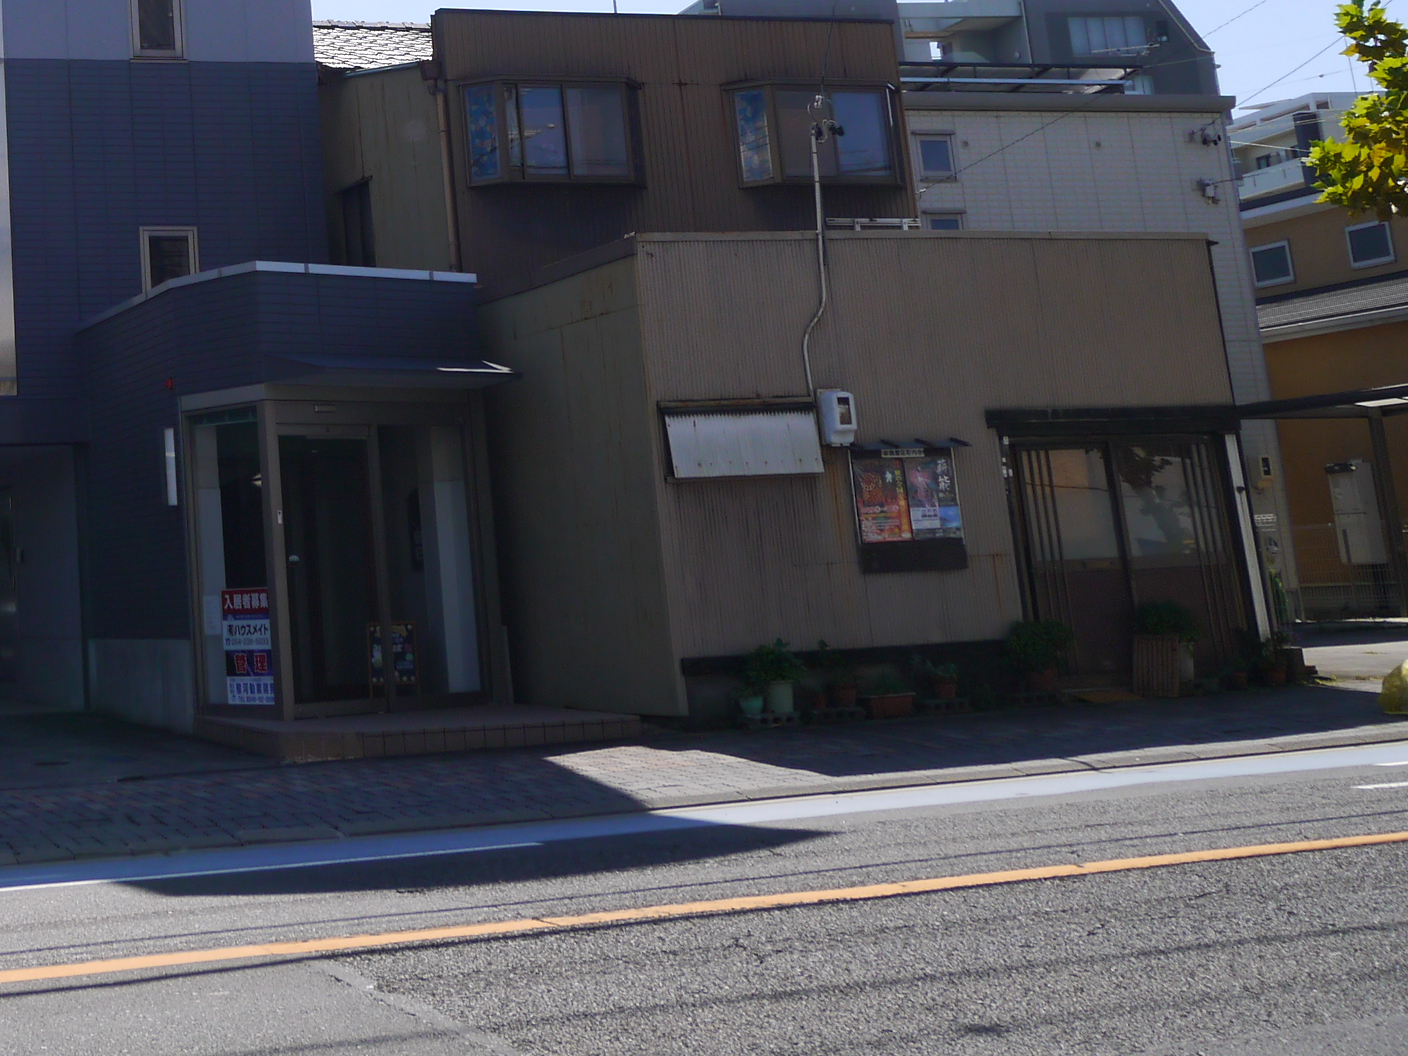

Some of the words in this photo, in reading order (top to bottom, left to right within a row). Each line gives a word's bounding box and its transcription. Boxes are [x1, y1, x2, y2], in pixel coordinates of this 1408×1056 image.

[223, 593, 269, 610] 入居者募集
